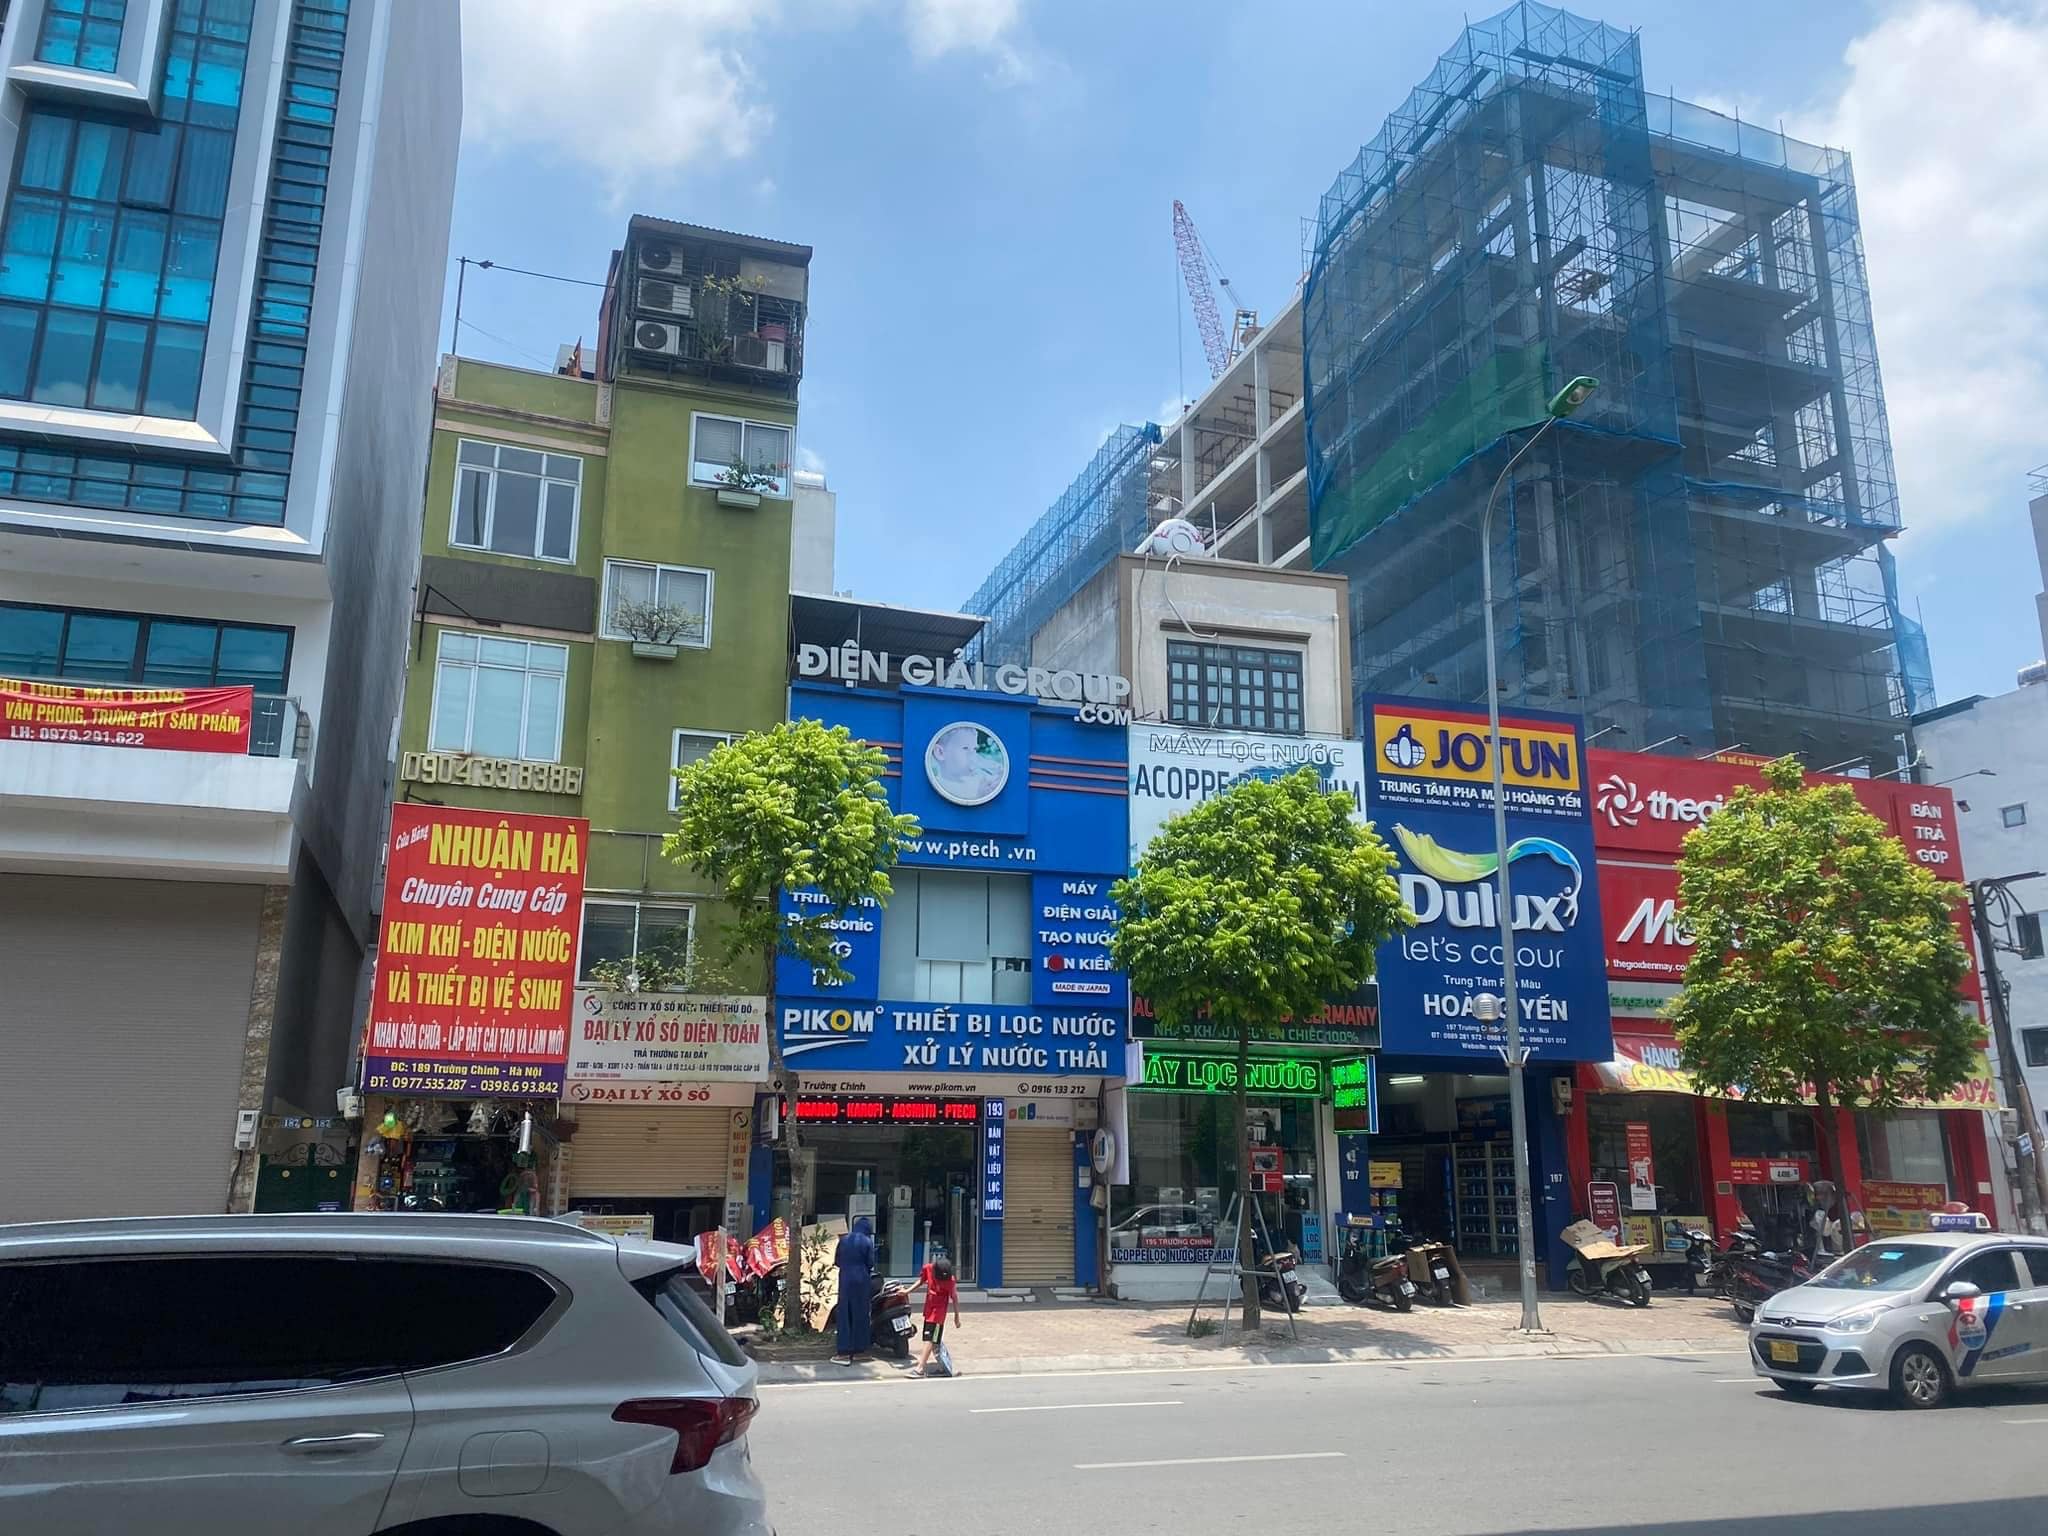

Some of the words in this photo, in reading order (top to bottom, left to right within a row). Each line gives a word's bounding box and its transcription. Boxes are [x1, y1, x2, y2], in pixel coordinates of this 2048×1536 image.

[797, 639, 888, 688] ĐIỆN
[901, 648, 985, 690] GIẢI
[995, 663, 1131, 705] GROUP
[5, 699, 33, 721] VĂN
[139, 707, 169, 729] BÀY
[170, 707, 198, 731] SẢN
[202, 709, 241, 735] PHẨM
[1073, 703, 1132, 726] .COM
[10, 726, 35, 740] LH:
[1149, 731, 1211, 757] MÁY
[1218, 740, 1265, 763] LỌC
[1272, 743, 1344, 767] NƯỚC
[1432, 729, 1570, 780] JOTUN
[1379, 780, 1421, 795] TRUNG
[1423, 781, 1451, 797] TÂM
[1453, 787, 1479, 800] PHA
[1481, 788, 1512, 803] MU
[1513, 789, 1554, 807] HOÀNG
[1556, 790, 1582, 809] YẾN
[1911, 800, 1942, 819] BÁN
[1912, 823, 1946, 841] TRẢ
[429, 819, 533, 879] NHUẬN
[541, 824, 579, 874] HÀ
[1916, 845, 1949, 864] GÓP
[401, 877, 474, 909] Chuyên
[476, 882, 527, 914] Cung
[529, 882, 568, 916] Cấp
[1063, 880, 1098, 895] MÁY
[1399, 872, 1565, 932] Dulux
[1043, 904, 1081, 922] ĐIỆN
[1084, 905, 1117, 921] GIẢI
[386, 921, 425, 955] KIM
[428, 919, 463, 957] KHÍ
[473, 922, 518, 967] ĐIỆN
[521, 925, 571, 964] NƯỚC
[1039, 931, 1072, 946] TẠO
[1402, 934, 1462, 963] let's
[1471, 945, 1564, 969] coour
[388, 964, 410, 1004] VÀ
[417, 964, 467, 1007] THIẾT
[469, 975, 488, 1015] BỊ
[493, 971, 516, 1015] VỆ
[519, 979, 563, 1011] SINH
[1055, 983, 1075, 991] MADE
[1085, 985, 1109, 993] JAPAN
[1443, 975, 1474, 988] Trung
[1475, 976, 1497, 987] Tâm
[612, 1000, 637, 1011] CÔNG
[638, 1001, 648, 1012] TY
[664, 1000, 675, 1012] SỐ
[1519, 993, 1569, 1021] YẾN
[783, 1008, 874, 1033] PIKOM
[893, 1005, 960, 1033] THIẾT
[967, 1015, 991, 1039] BỊ
[999, 1015, 1043, 1039] LỌC
[1052, 1013, 1117, 1037] NƯỚC
[373, 1018, 399, 1053] NHẬN
[399, 1015, 417, 1050] SỬA
[419, 1019, 441, 1051] CHỮA
[448, 1016, 464, 1052] LẮP
[465, 1023, 483, 1057] ĐẶT
[483, 1019, 497, 1053] CẢI
[500, 1026, 516, 1059] TẠO
[516, 1026, 528, 1054] VÀ
[529, 1026, 547, 1055] LÀM
[547, 1025, 565, 1056] MỚI
[584, 1020, 609, 1046] ĐẠI
[613, 1016, 632, 1041] LÝ
[635, 1013, 656, 1042] XỔ
[659, 1014, 682, 1042] SỐ
[683, 1018, 720, 1048] ĐIỆN
[722, 1019, 760, 1044] TOÁN
[1325, 1031, 1359, 1042] 100%
[903, 1038, 939, 1066] XỬ
[946, 1041, 972, 1066] LÝ
[982, 1042, 1048, 1068] NƯỚC
[1056, 1041, 1108, 1069] THẢI
[1640, 1042, 1680, 1069] HÀNG
[390, 1062, 409, 1073] ĐC:
[412, 1063, 431, 1074] 189
[433, 1062, 468, 1076] Trường
[470, 1064, 500, 1076] Chinh
[509, 1065, 523, 1076] Hà
[525, 1066, 542, 1077] Nội
[1146, 1054, 1180, 1084] ÁY
[1188, 1062, 1238, 1092] LỌC
[1246, 1060, 1317, 1090] NƯỚC
[370, 1076, 389, 1088] ĐT:
[392, 1077, 467, 1091] 0977.535.287
[592, 1087, 626, 1103] ĐẠI
[630, 1085, 652, 1101] LÝ
[657, 1082, 683, 1101] XỔ
[687, 1083, 711, 1102] SỐ
[803, 1081, 837, 1092] Trường
[840, 1081, 866, 1091] Chinh
[908, 1081, 977, 1094] www.pikom.vn
[1031, 1085, 1052, 1094] 0916
[1054, 1085, 1068, 1094] 133
[1070, 1085, 1086, 1095] 212
[945, 1103, 977, 1119] PTECH
[987, 1102, 1003, 1117] 193
[284, 1119, 300, 1128] 187
[315, 1119, 331, 1128] 187
[988, 1125, 1001, 1139] BÁN
[988, 1144, 1000, 1159] VẬT
[987, 1163, 1001, 1177] LIỆU
[1346, 1170, 1360, 1181] 197
[1550, 1173, 1563, 1183] 197
[988, 1182, 1000, 1195] LỌC
[985, 1197, 1003, 1211] NƯỚC
